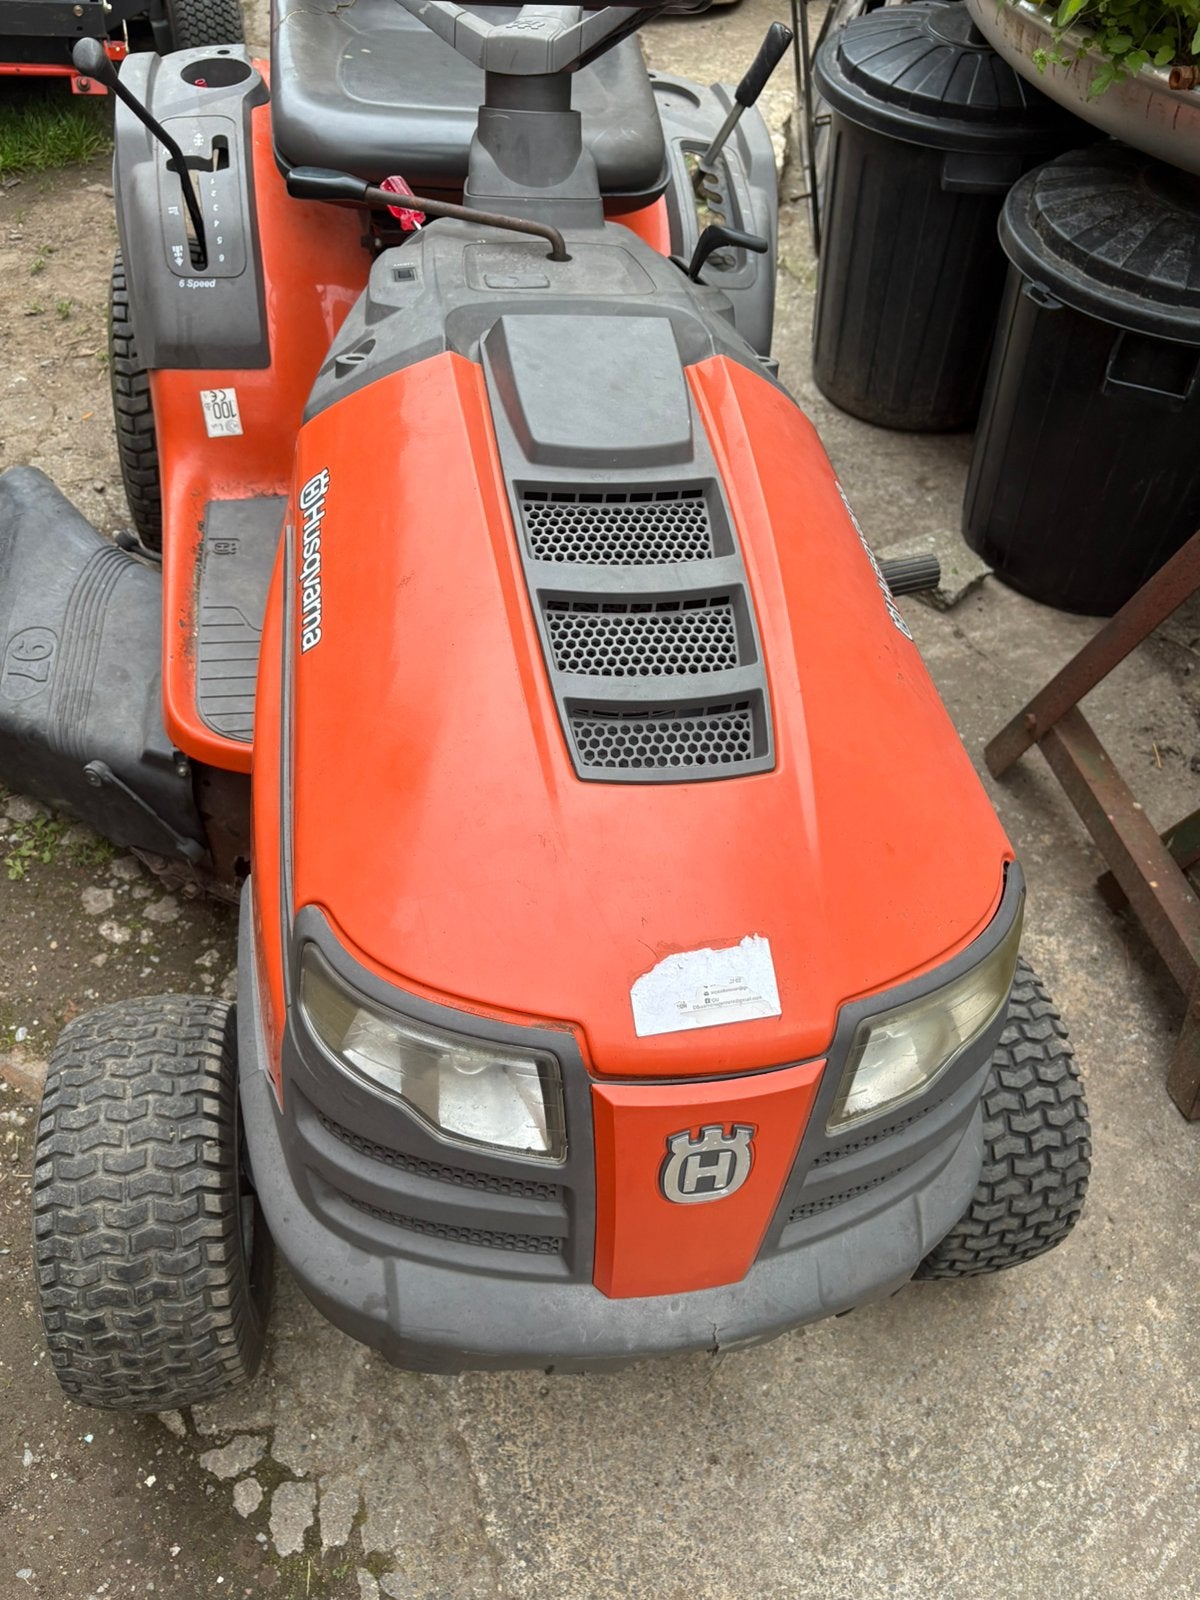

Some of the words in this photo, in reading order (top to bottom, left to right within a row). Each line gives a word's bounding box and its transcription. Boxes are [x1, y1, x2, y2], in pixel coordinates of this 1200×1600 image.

[216, 236, 223, 245] 5
[218, 254, 225, 262] 6
[178, 279, 185, 288] 6
[186, 279, 216, 290] Speed
[212, 401, 237, 420] 100
[299, 498, 326, 655] Husqvarna
